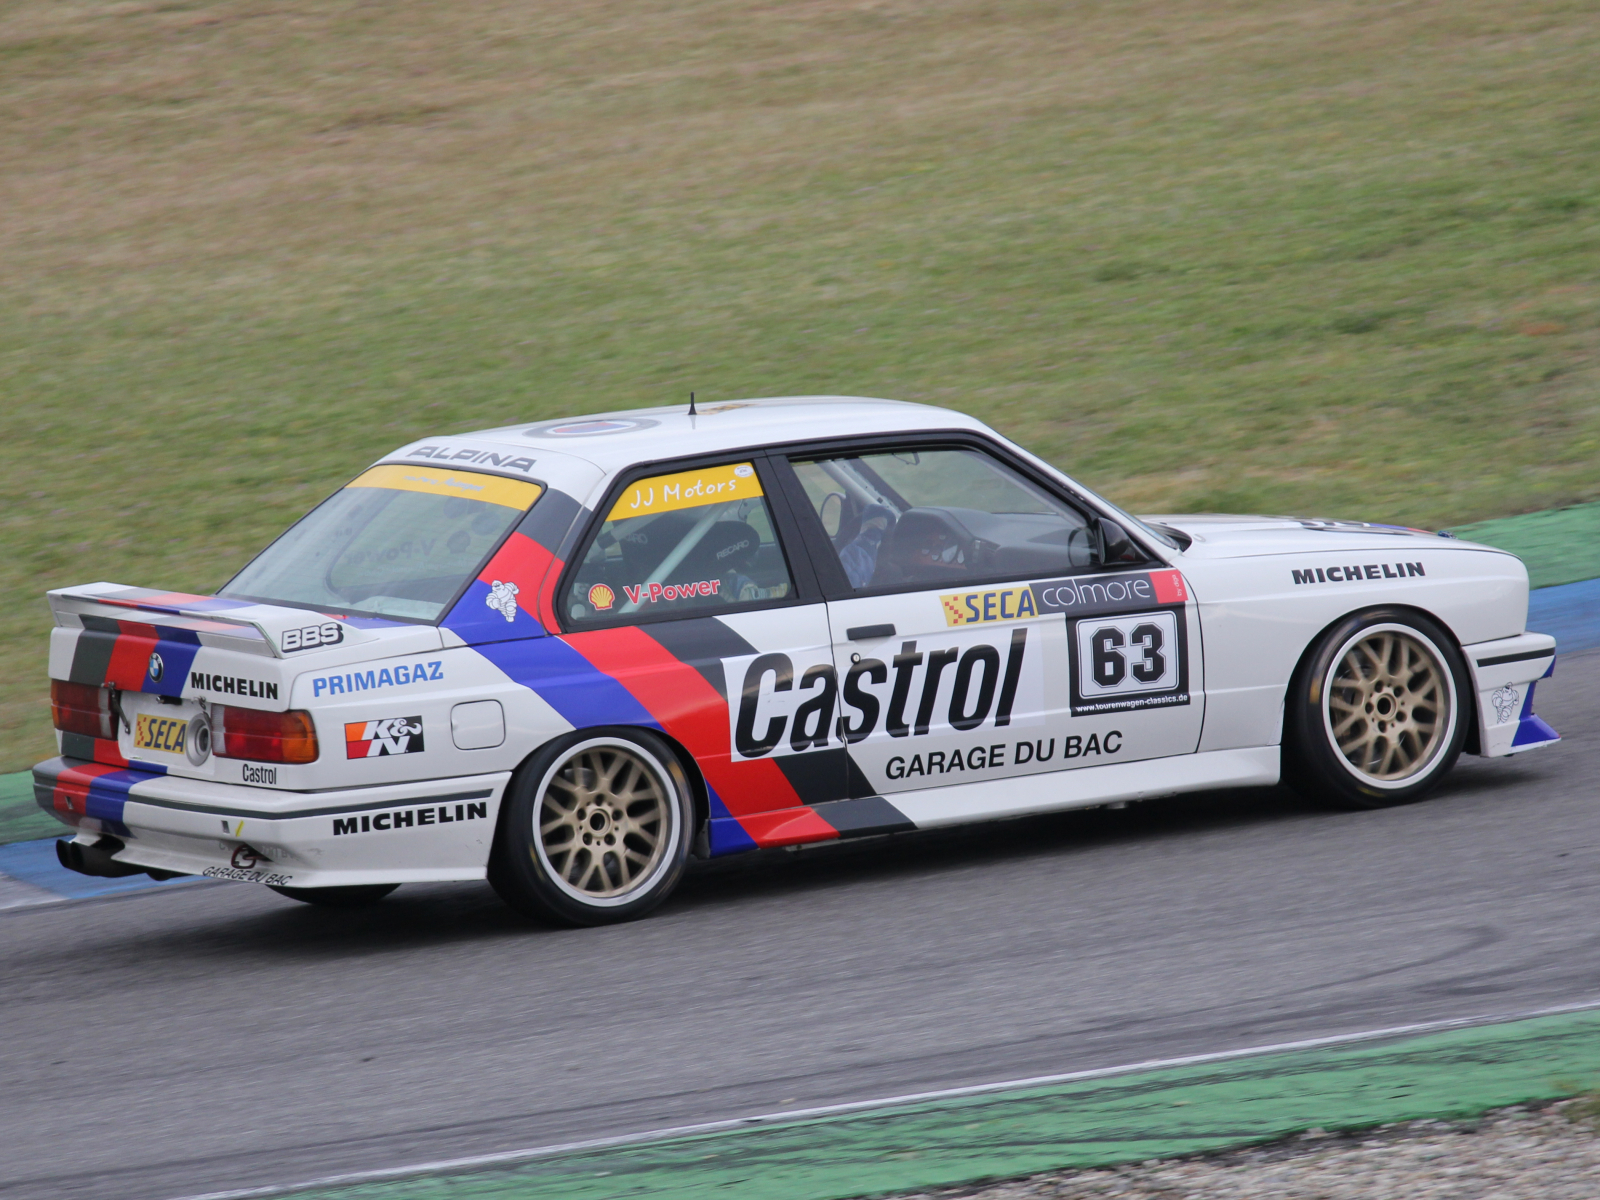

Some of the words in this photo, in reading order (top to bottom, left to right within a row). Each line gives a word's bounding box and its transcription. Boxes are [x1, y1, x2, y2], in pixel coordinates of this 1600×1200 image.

[405, 446, 537, 473] ALPINA
[630, 487, 654, 510] JJ
[663, 479, 736, 503] Motors
[716, 540, 749, 560] RECARO
[1291, 562, 1425, 585] MICHELIN
[623, 579, 720, 604] V-Power
[965, 589, 1035, 623] SECA
[1042, 578, 1151, 607] colmore
[282, 622, 343, 654] BBS
[1090, 622, 1166, 688] 63
[190, 672, 278, 701] MICHELIN
[313, 660, 444, 698] PRIMAGAZ
[735, 628, 1028, 759] Castrol
[1075, 693, 1188, 713] www.tourenwagen-classics.de
[144, 718, 187, 753] SECA
[885, 743, 1005, 780] GARAGE
[1013, 738, 1055, 766] DU
[1063, 730, 1123, 759] BAC
[242, 763, 277, 785] Castrol
[333, 802, 487, 836] MICHELIN
[202, 866, 253, 881] GARAGE
[247, 871, 267, 883] DU
[265, 874, 293, 886] BAC
